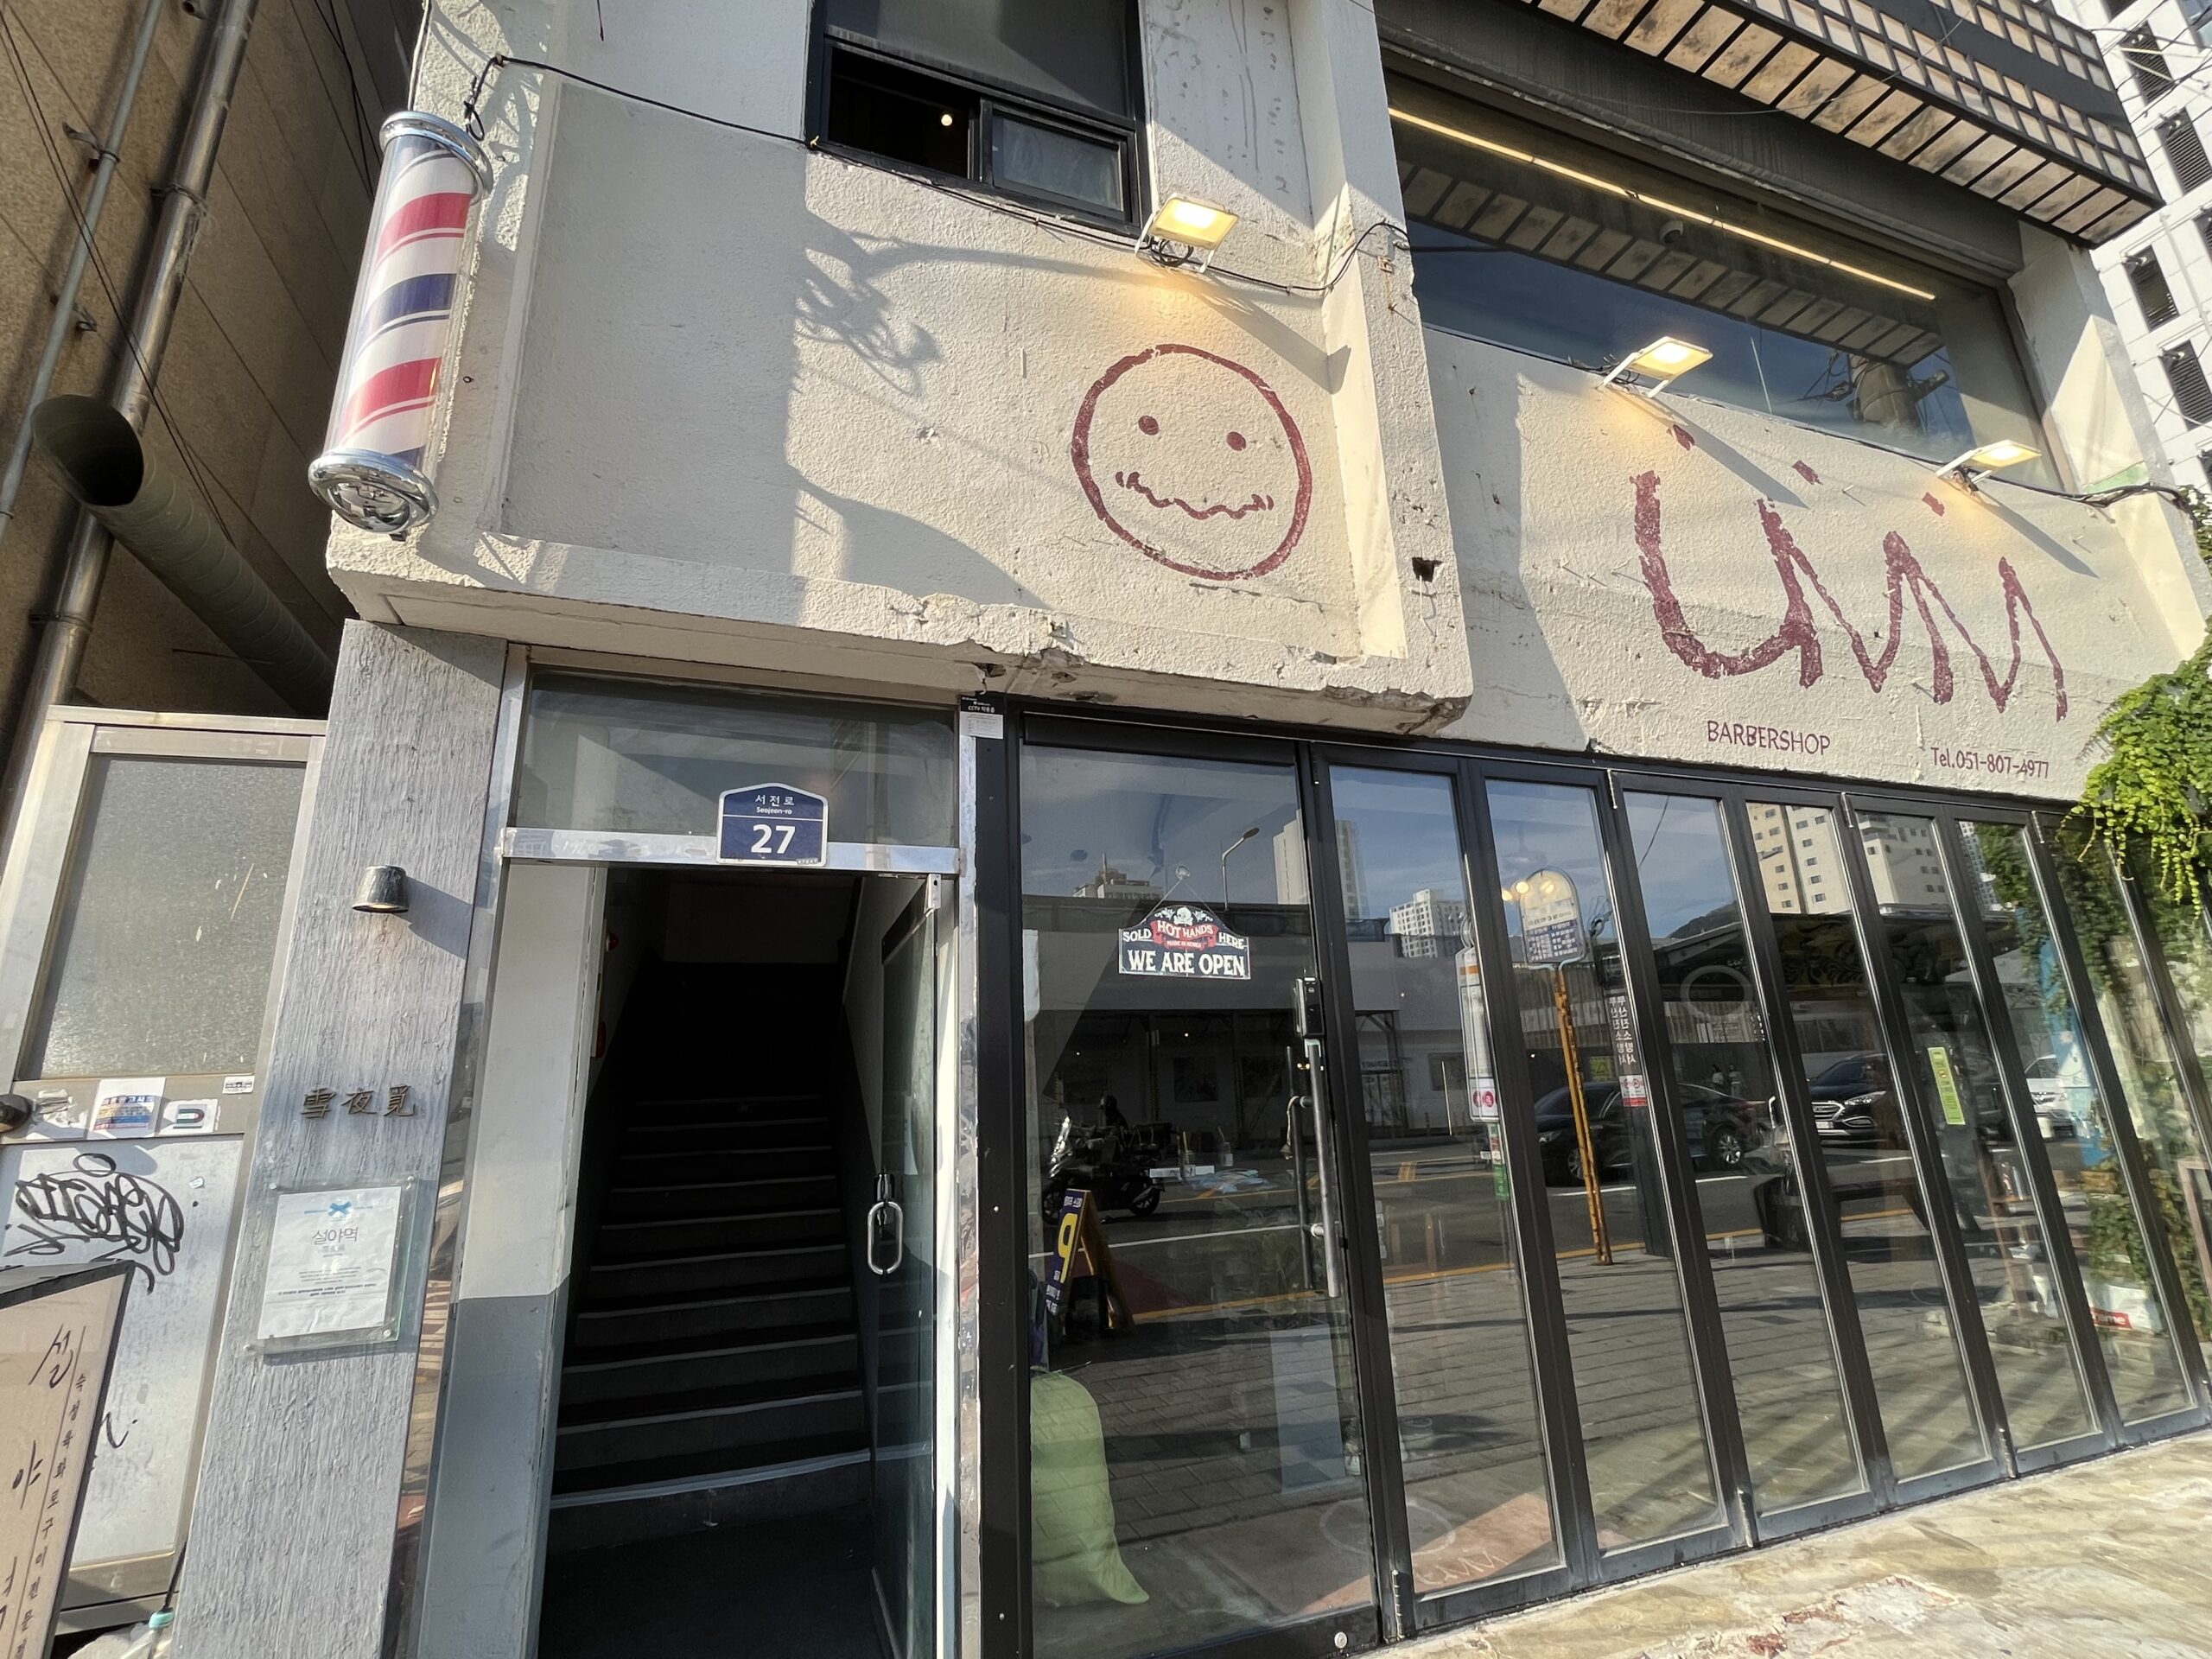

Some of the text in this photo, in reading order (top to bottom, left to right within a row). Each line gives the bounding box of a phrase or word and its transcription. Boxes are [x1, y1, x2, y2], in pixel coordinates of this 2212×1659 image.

[1707, 720, 1831, 755] BARBERSHOP
[755, 794, 795, 807] 서전로
[756, 806, 793, 815] Seojeon-ro
[751, 823, 796, 855] 27
[1157, 919, 1214, 938] HOT HANDS
[1122, 928, 1245, 950] SOLD HERE
[1127, 949, 1244, 976] WE ARE OPEN
[312, 1227, 359, 1245] 설야멱
